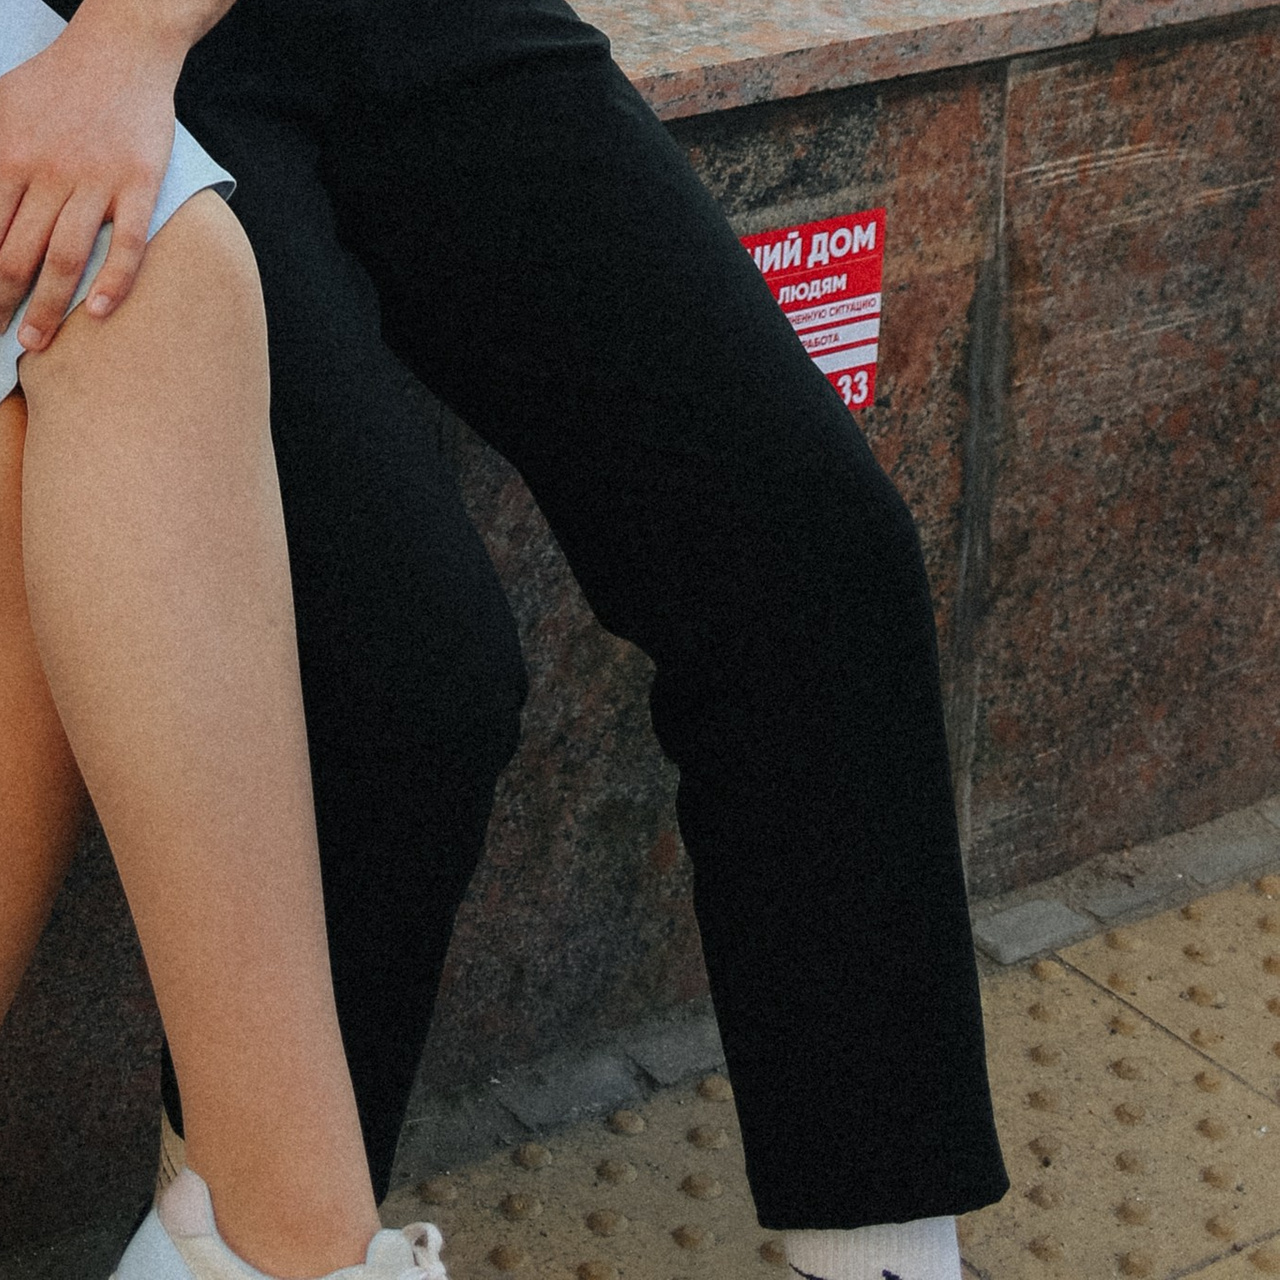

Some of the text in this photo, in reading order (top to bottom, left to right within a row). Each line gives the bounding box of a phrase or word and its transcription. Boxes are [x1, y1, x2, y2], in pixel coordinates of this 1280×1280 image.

[807, 221, 877, 269] ДОМ
[777, 273, 848, 305] ЛЮДЯМ
[828, 297, 877, 317] СИТУАЦИЮ
[836, 370, 869, 406] 33
